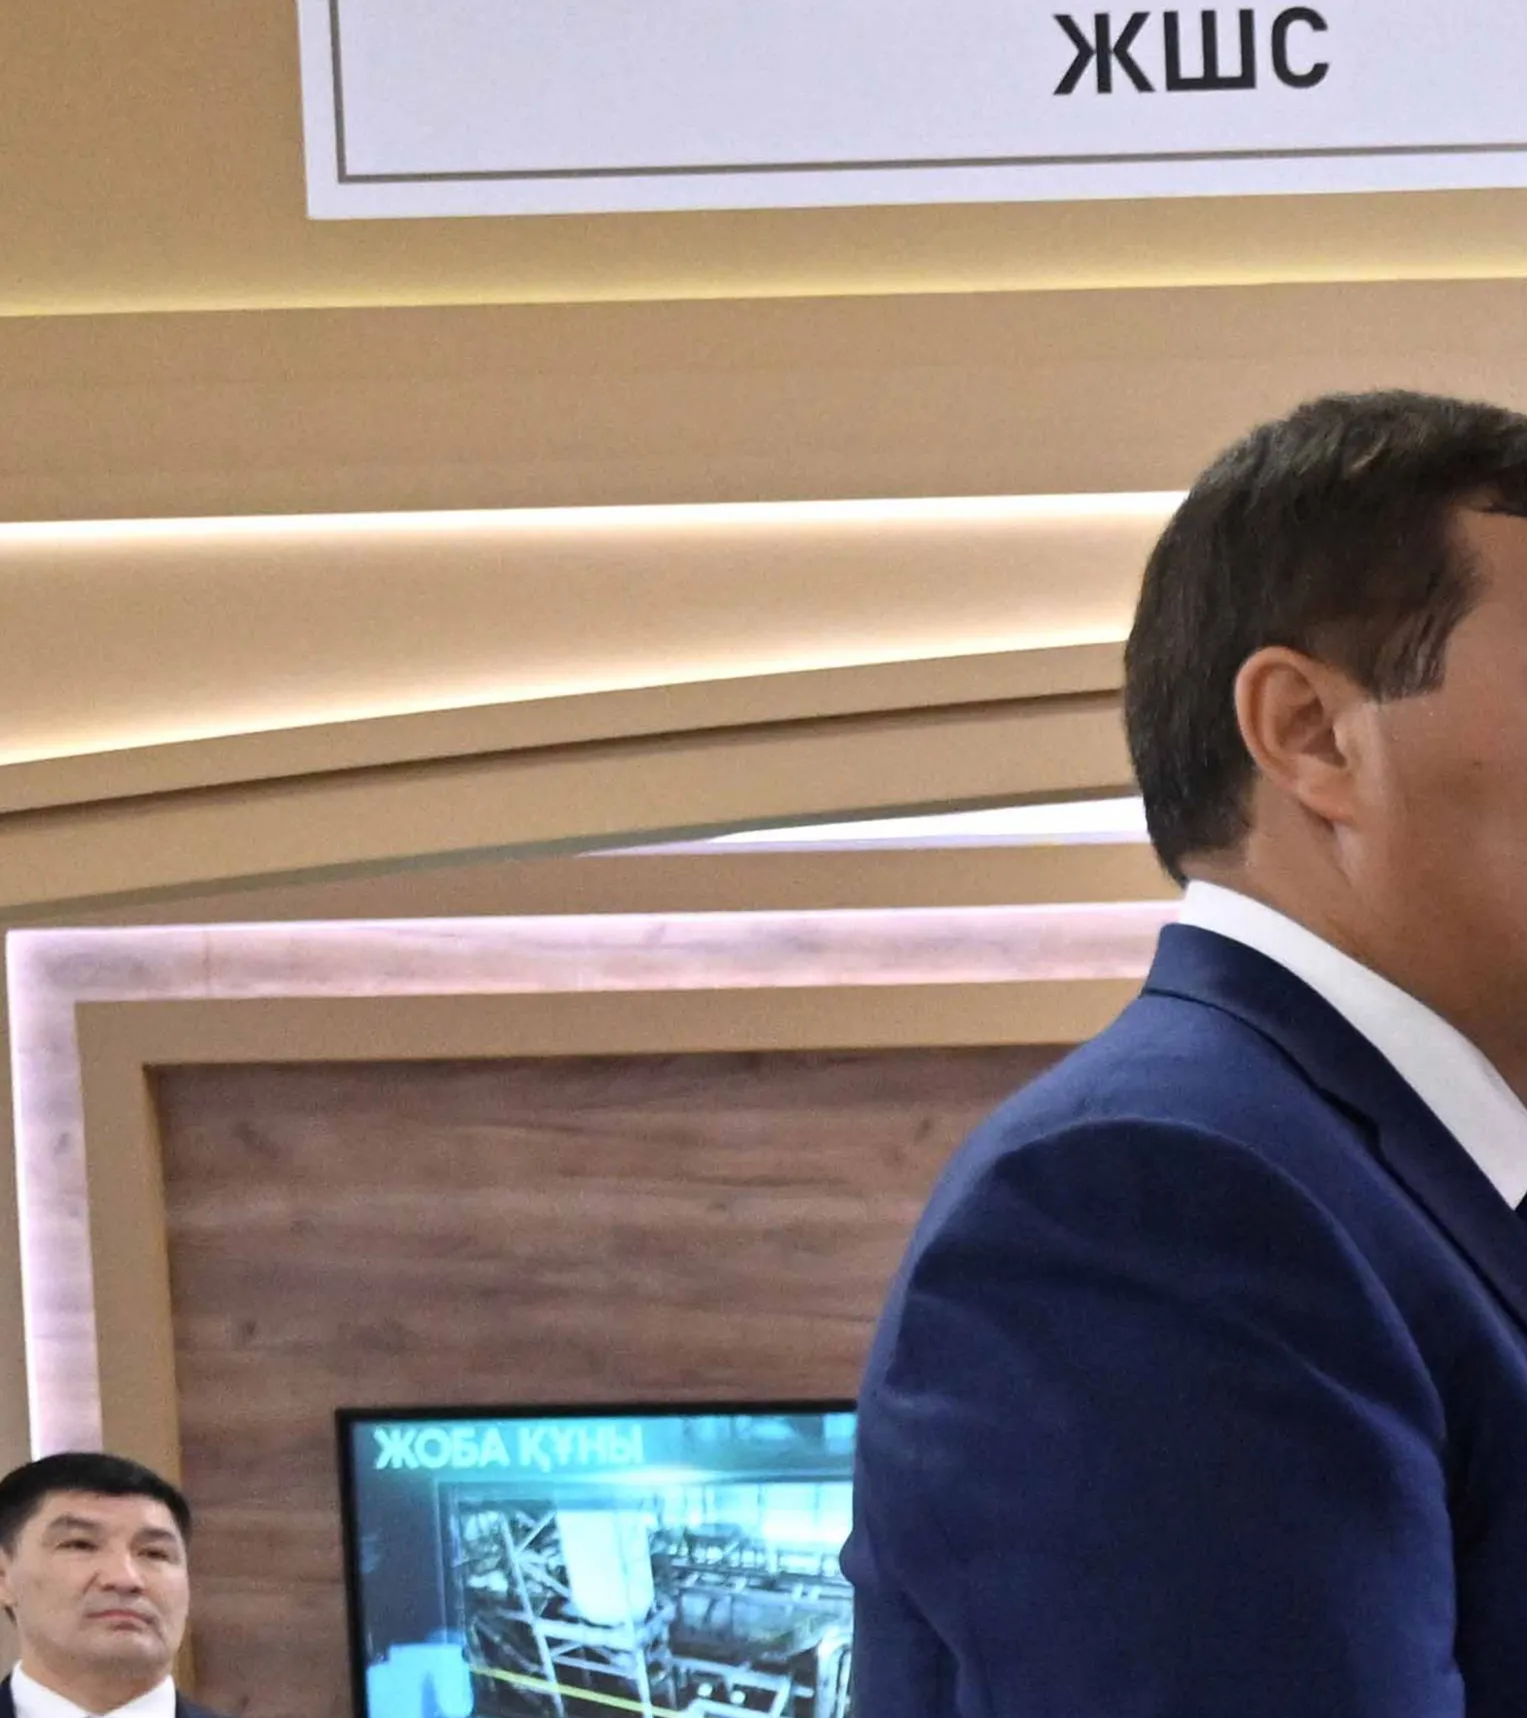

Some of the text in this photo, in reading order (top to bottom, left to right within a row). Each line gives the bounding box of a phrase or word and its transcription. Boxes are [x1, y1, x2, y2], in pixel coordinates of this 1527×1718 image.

[1053, 6, 1329, 95] ЖШС
[373, 1424, 645, 1473] ЖОБА ҚҰНЫ
